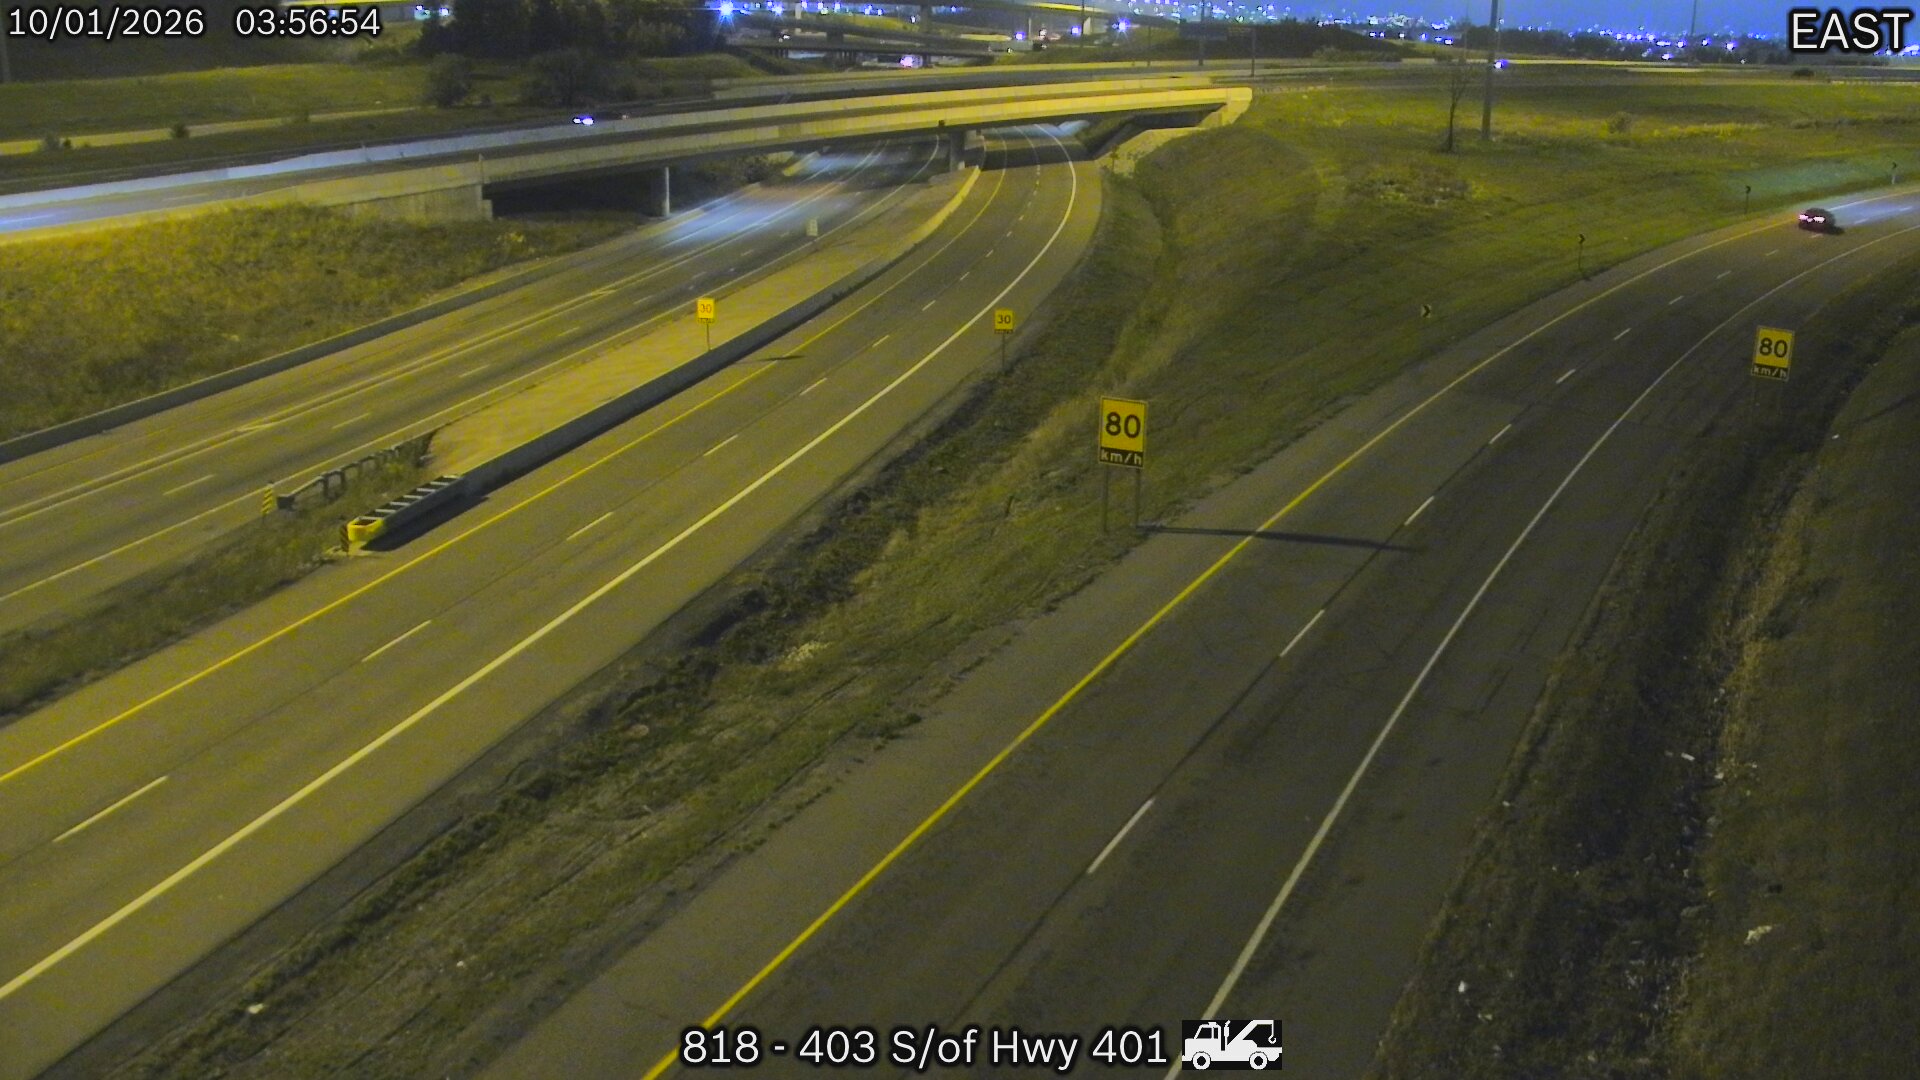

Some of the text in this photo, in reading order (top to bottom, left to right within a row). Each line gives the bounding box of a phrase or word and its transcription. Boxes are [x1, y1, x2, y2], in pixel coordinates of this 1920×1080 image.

[997, 314, 1010, 324] 30
[1759, 337, 1788, 358] 80
[1105, 411, 1141, 438] 80
[1101, 448, 1142, 466] km/h
